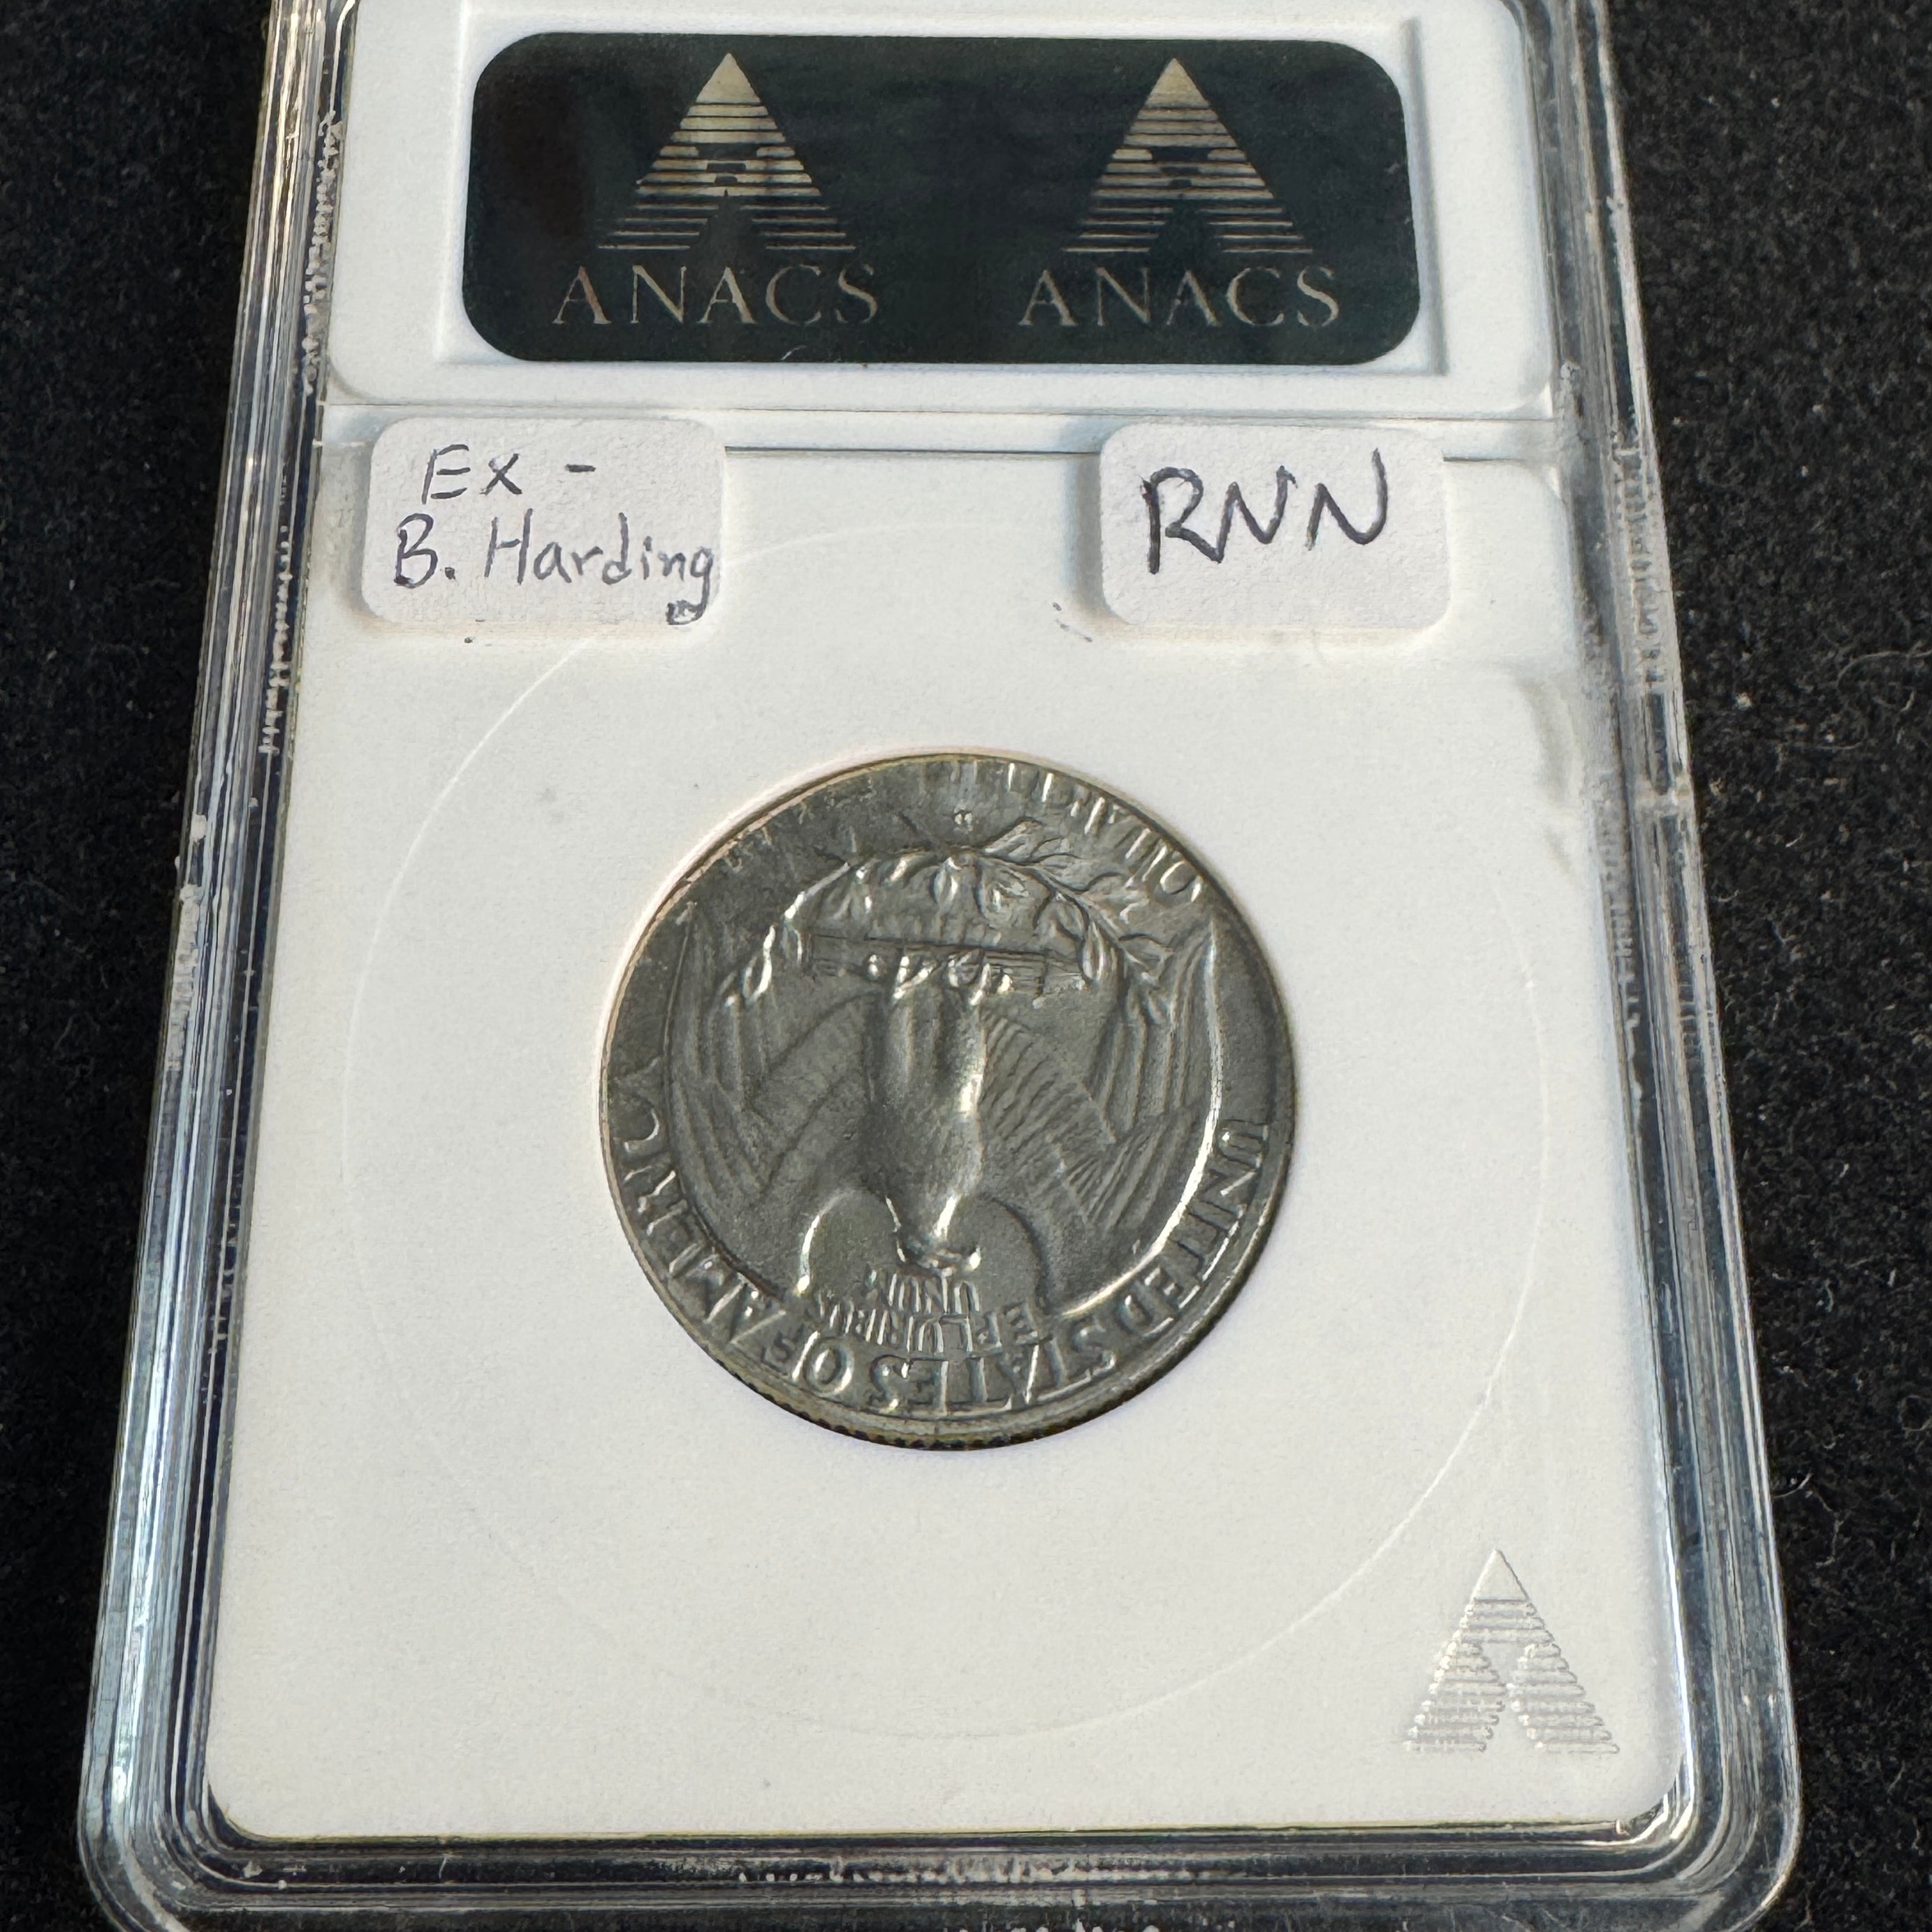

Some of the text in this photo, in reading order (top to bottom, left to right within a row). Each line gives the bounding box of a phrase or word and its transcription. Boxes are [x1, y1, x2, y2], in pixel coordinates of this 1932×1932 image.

[552, 263, 879, 325] ANACS
[1017, 265, 1340, 327] ANACS
[421, 444, 522, 504] Ex
[393, 507, 715, 625] B. Harding
[759, 1327, 856, 1396] OF
[868, 1317, 1118, 1418] STATES
